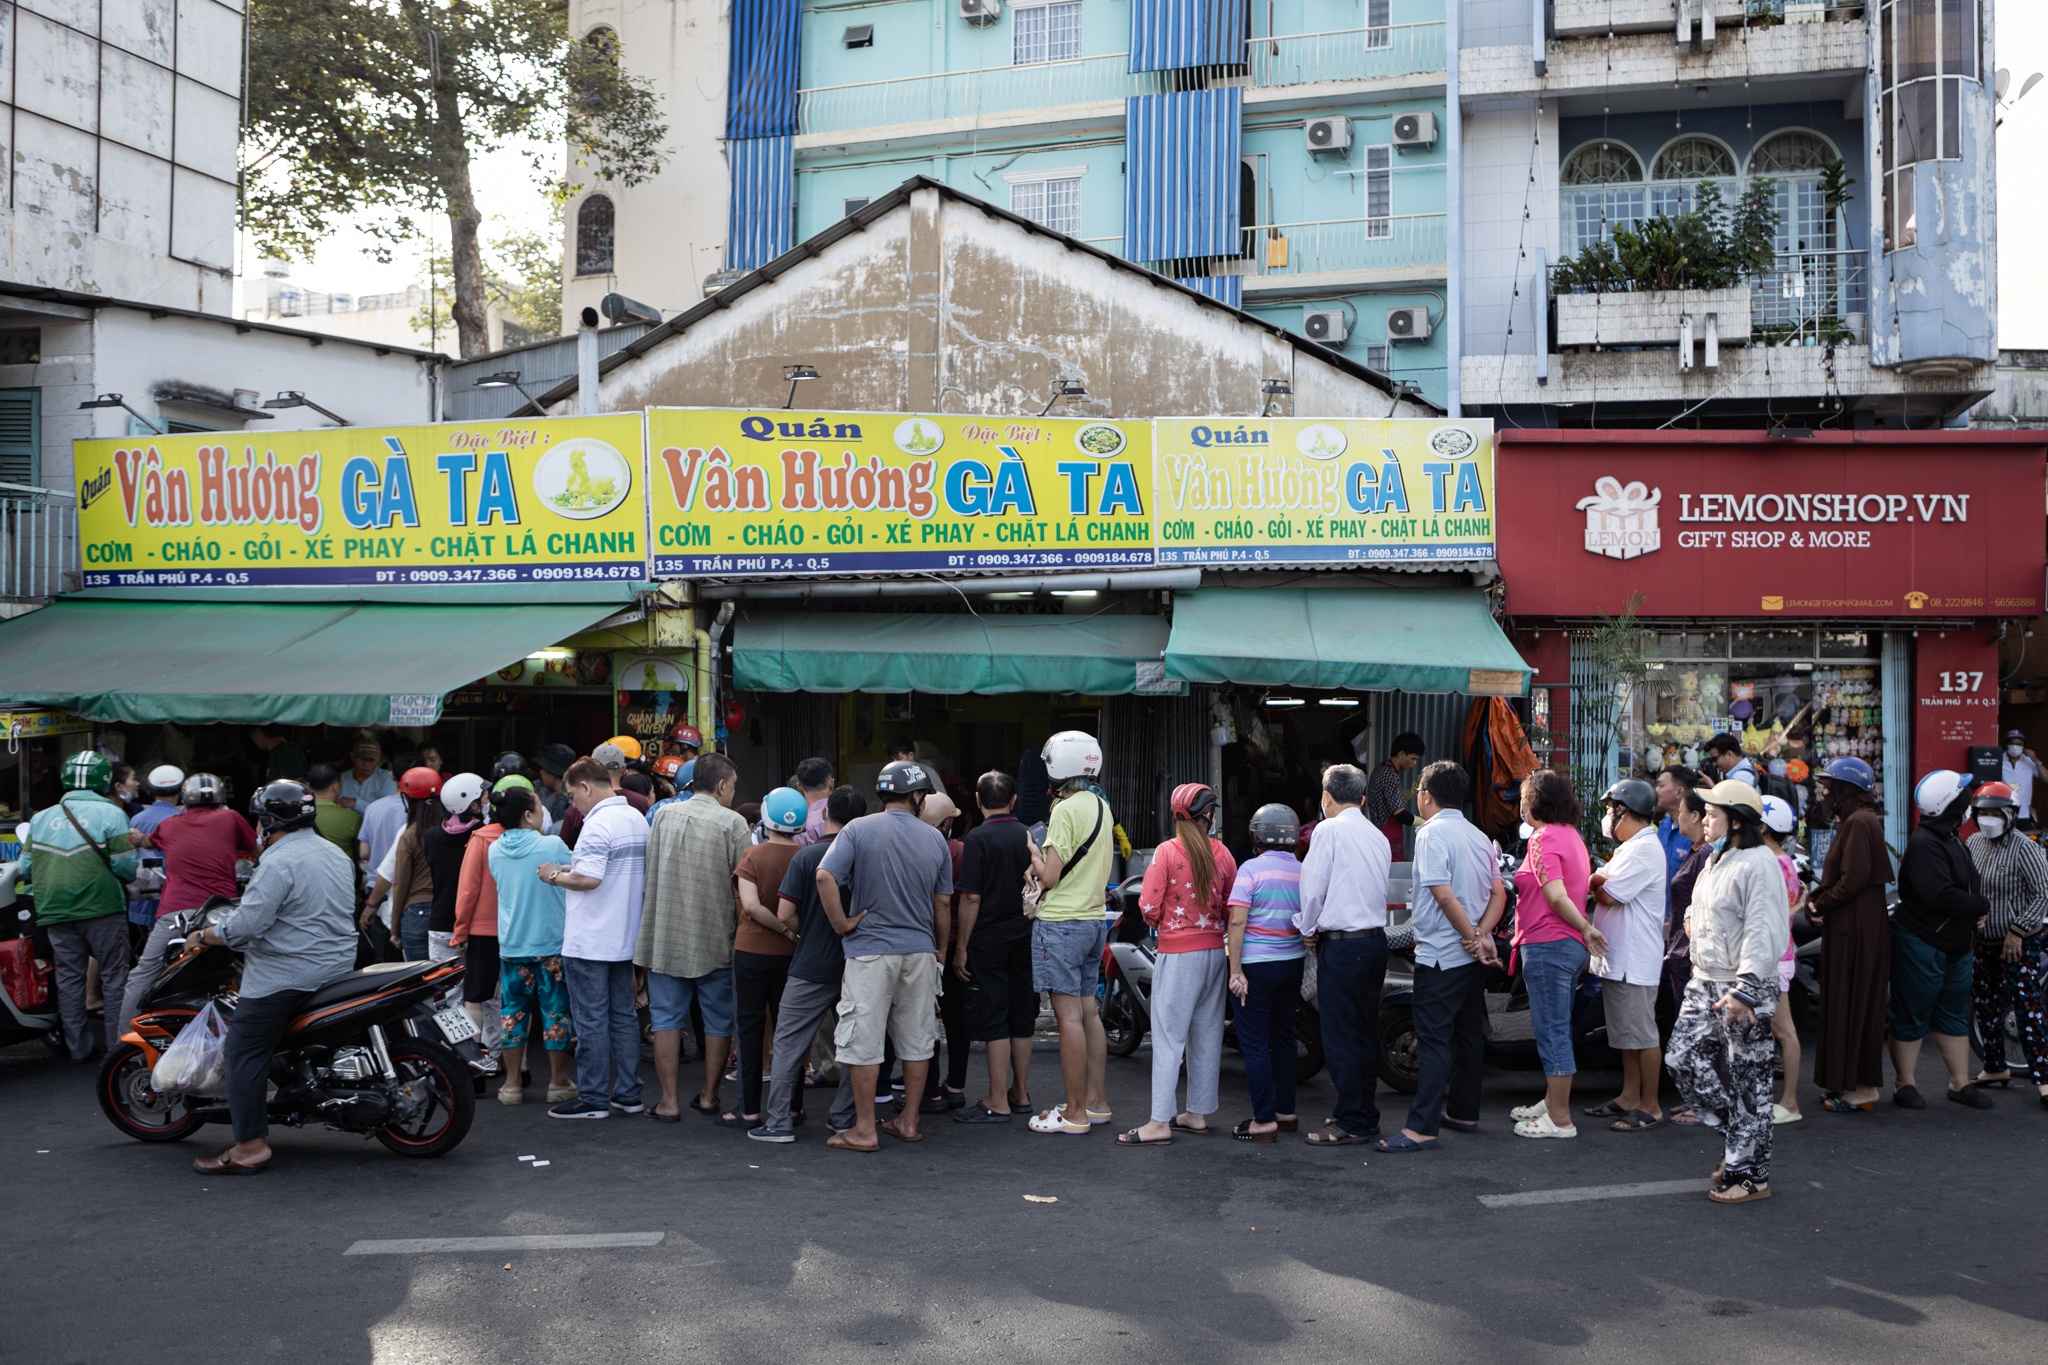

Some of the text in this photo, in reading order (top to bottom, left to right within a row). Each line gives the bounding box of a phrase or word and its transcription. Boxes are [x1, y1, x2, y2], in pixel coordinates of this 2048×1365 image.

[450, 431, 490, 451] Đặc
[495, 428, 538, 449] Biệt
[740, 416, 863, 442] Quán
[961, 423, 999, 445] Đặc
[1004, 424, 1041, 445] Biệt
[1191, 425, 1269, 447] Quán
[81, 467, 112, 510] Quán
[114, 436, 521, 535] Vân Hương GÀ TA
[661, 445, 1144, 520] Vân Hương GÀ TA
[1163, 448, 1486, 518] Vân Hương GÀ TA
[1678, 494, 1970, 522] LEMONSHOP.VN
[659, 522, 711, 547] CƠM
[742, 519, 805, 546] CHÁO
[826, 516, 863, 545] GỎI
[885, 518, 912, 544] XÉ
[921, 523, 975, 544] PHAY
[996, 518, 1048, 547] CHẶT
[1056, 517, 1080, 542] LÁ
[1086, 521, 1149, 542] CHANH
[1163, 518, 1195, 540] CƠM
[1214, 516, 1253, 539] CHÁO
[1267, 513, 1292, 539] GỎI
[1306, 516, 1324, 538] XÉ
[1330, 519, 1366, 538] PHAY
[1381, 515, 1417, 542] CHẶT
[1423, 514, 1440, 537] LÁ
[1445, 518, 1490, 537] CHANH
[86, 540, 133, 563] CƠM
[161, 536, 221, 562] CHÁO
[244, 532, 282, 560] GỎI
[305, 534, 334, 559] XÉ
[344, 538, 405, 559] PHAY
[430, 532, 496, 562] CHẶT
[506, 529, 538, 556] LÁ
[548, 532, 635, 555] CHANH
[1586, 530, 1659, 547] LEMON
[1678, 531, 1871, 548] GIFT SHOP & MORE
[656, 559, 683, 572] 135
[693, 553, 732, 570] TRẦN
[737, 555, 766, 571] PHÚ
[770, 557, 793, 569] P.4
[807, 557, 831, 571] Q.5
[948, 555, 965, 566] ĐT
[977, 553, 1064, 565] 0909.347.366
[1074, 551, 1152, 564] 0909184.678
[1160, 551, 1178, 561] 135
[1183, 547, 1208, 561] TRẦN
[1211, 548, 1229, 560] PHÚ
[1231, 550, 1247, 560] P.4
[1255, 549, 1269, 561] Q.5
[1348, 549, 1360, 559] ĐT
[1368, 547, 1428, 559] 0909.347.366
[1436, 546, 1492, 558] 0909184.678
[85, 574, 111, 585] 135
[117, 570, 155, 585] TRẦN
[158, 571, 187, 584] PHÚ
[190, 573, 213, 584] P.4
[225, 572, 249, 584] Q.5
[376, 570, 396, 582] ĐT
[409, 568, 517, 582] 0909.347.366
[532, 566, 641, 580] 0909184.678
[1786, 599, 1893, 608] LEMONGIFTSHOP@GMAIL.COM
[1939, 671, 1984, 692] 137
[1966, 698, 1979, 706] P.4
[1982, 698, 1996, 707] Q.5
[438, 1009, 466, 1027] 54-H4
[448, 1022, 475, 1041] 2306
